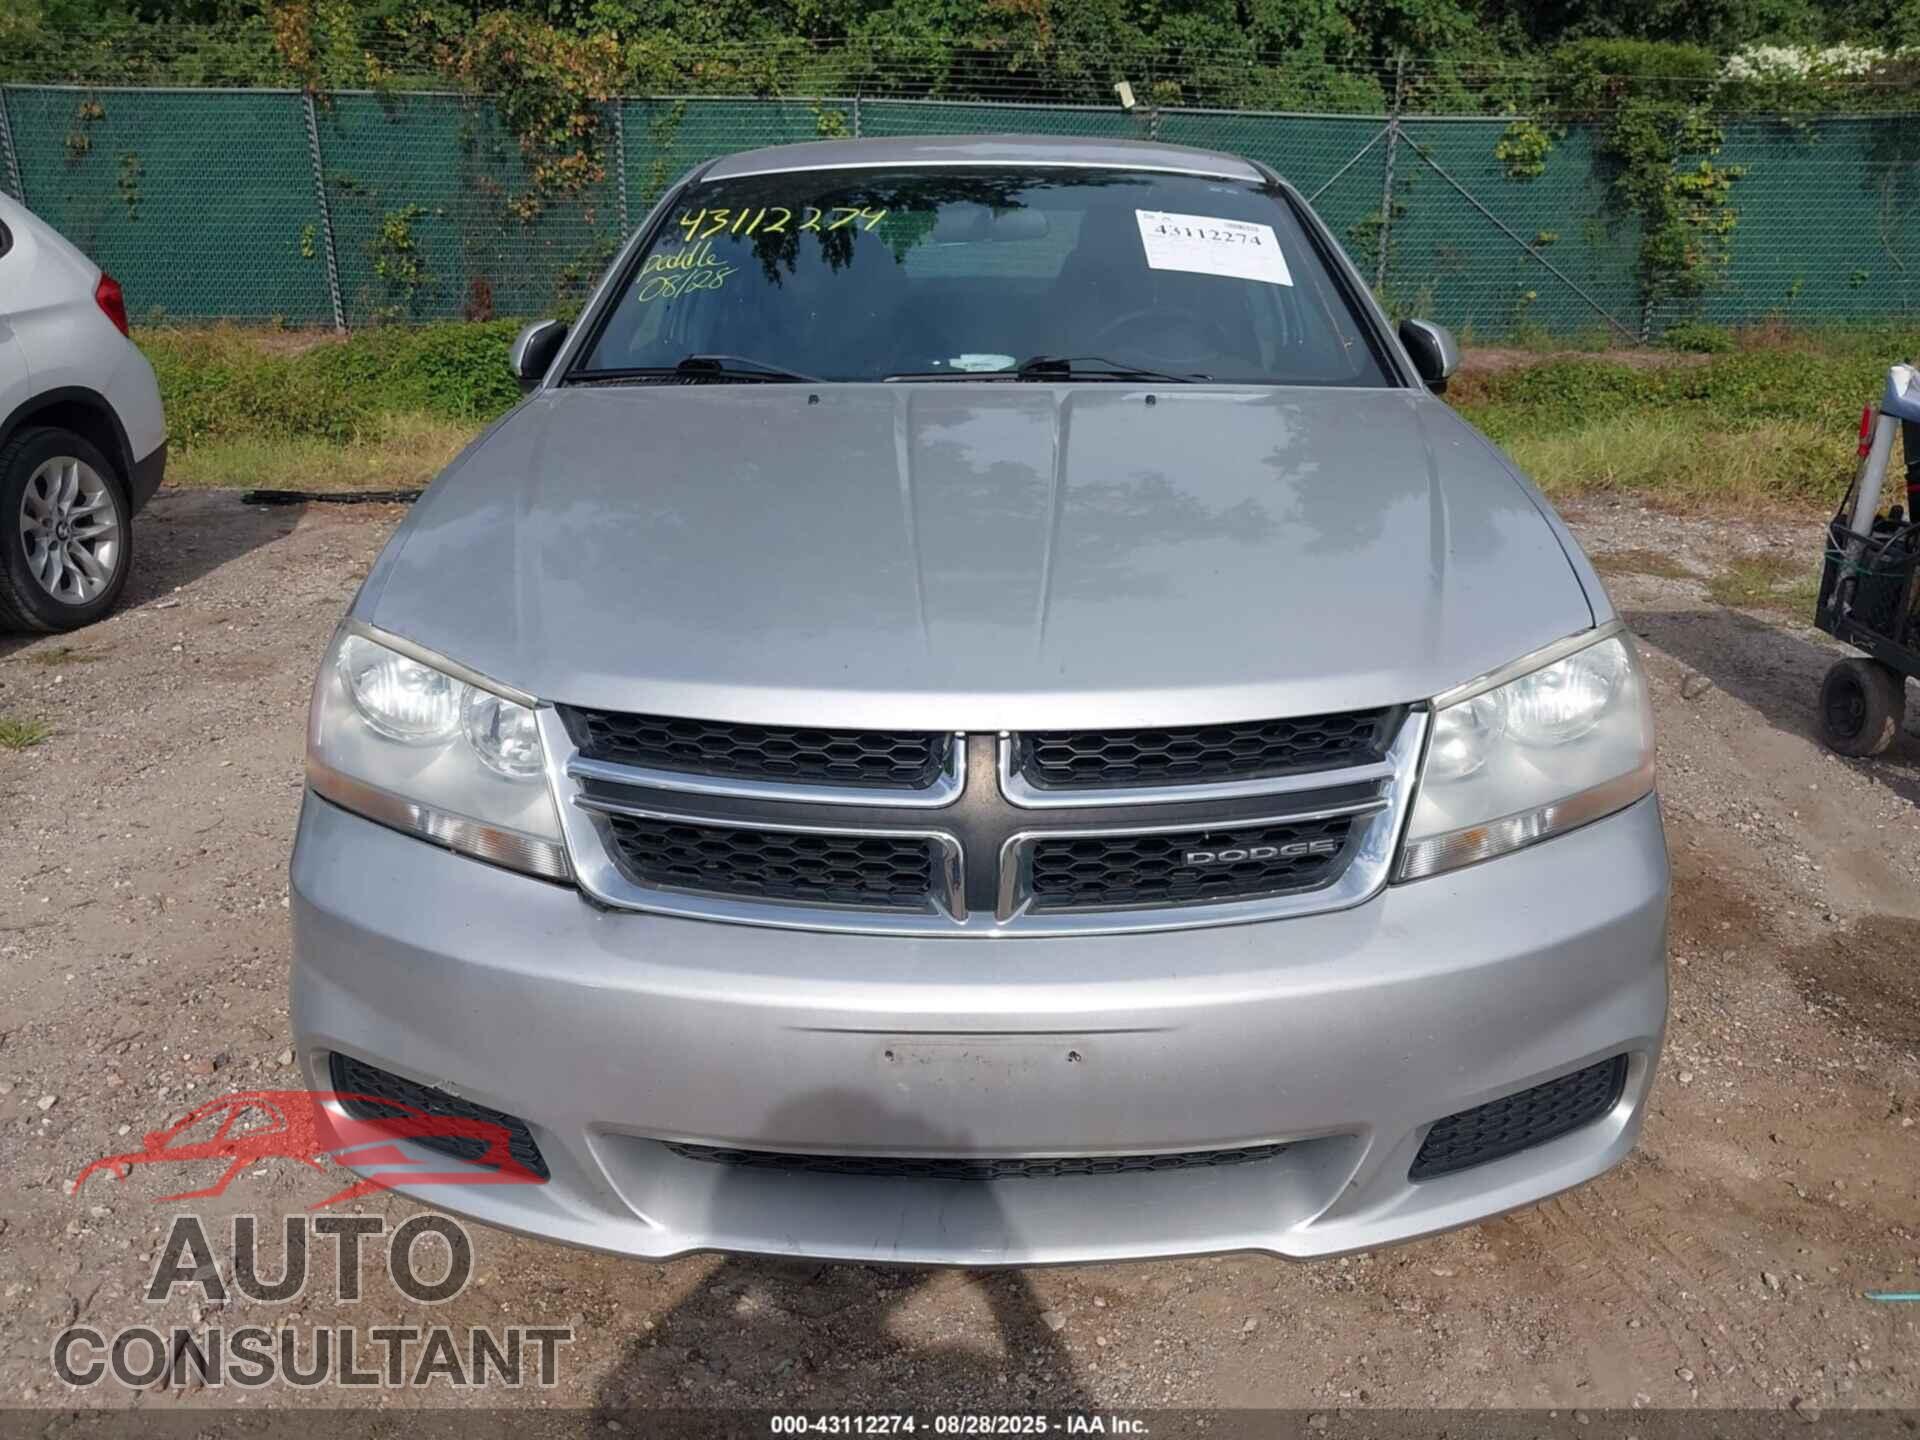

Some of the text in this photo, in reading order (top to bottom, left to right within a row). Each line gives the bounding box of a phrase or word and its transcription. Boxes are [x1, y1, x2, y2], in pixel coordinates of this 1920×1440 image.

[680, 208, 887, 241] 43112274
[1155, 225, 1262, 246] 43112274
[1187, 839, 1335, 865] DODGE
